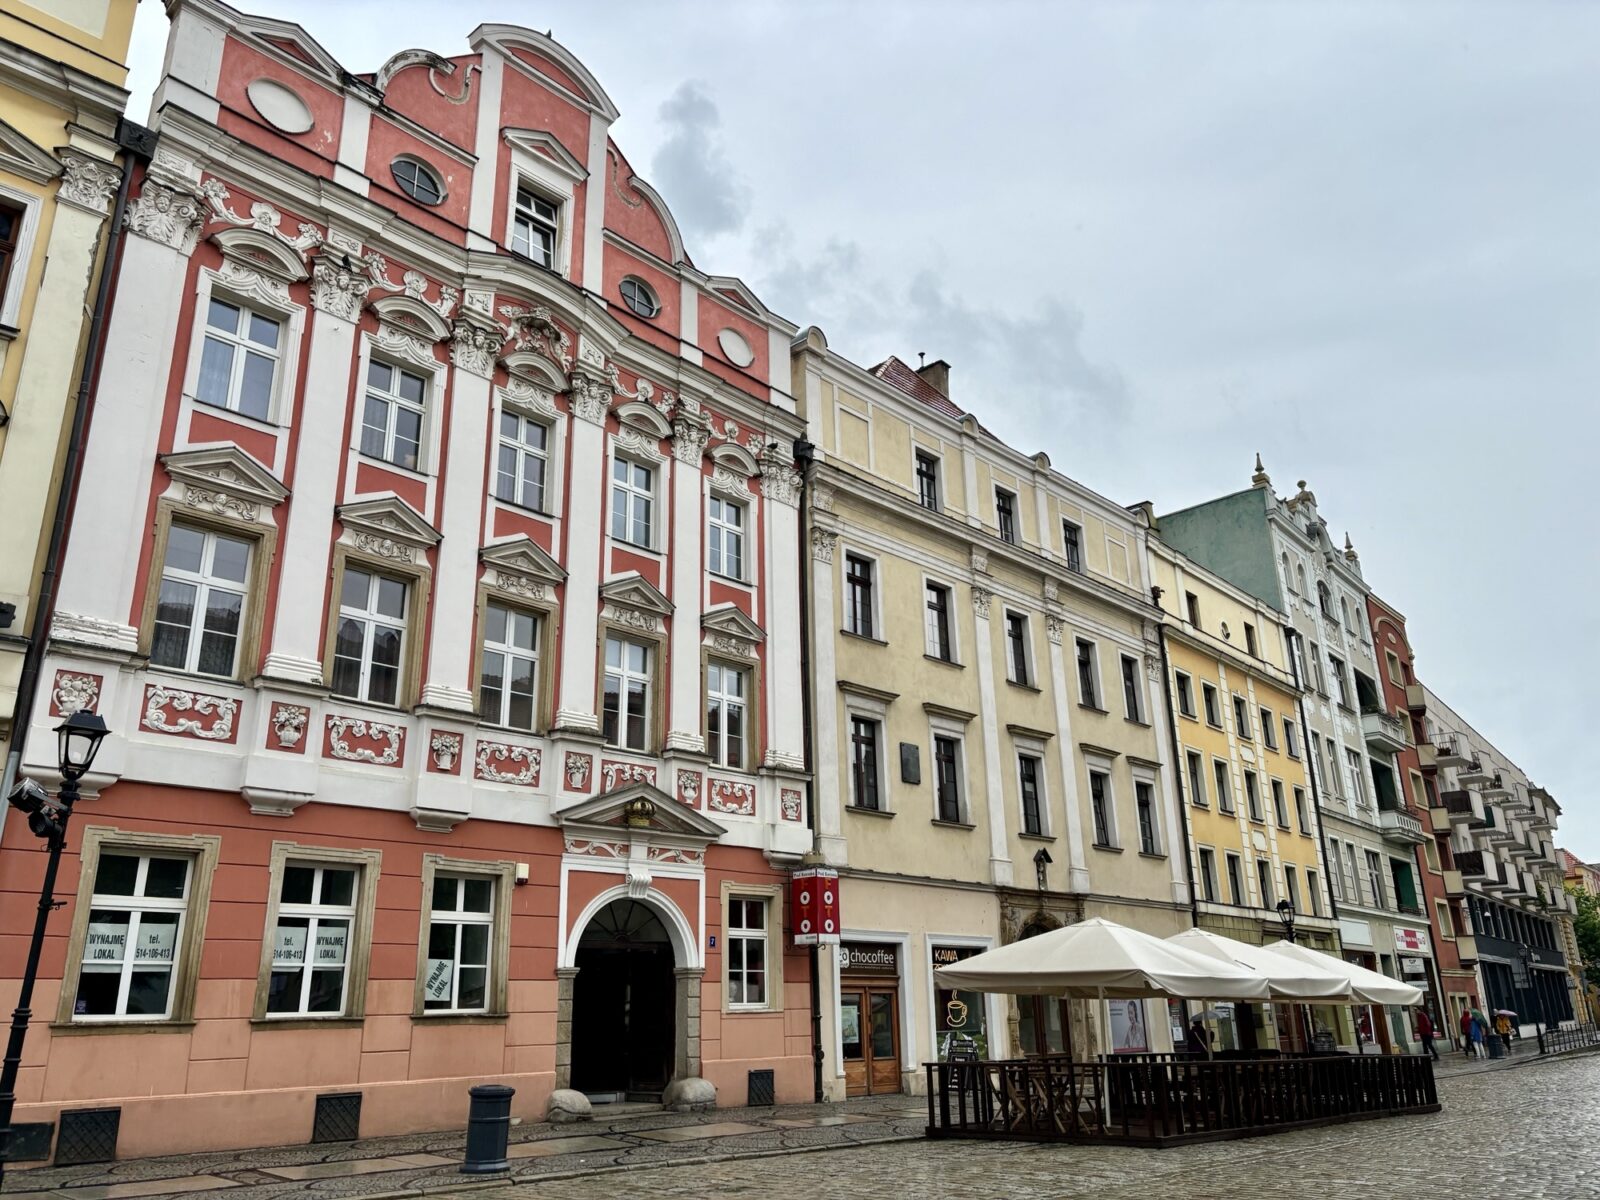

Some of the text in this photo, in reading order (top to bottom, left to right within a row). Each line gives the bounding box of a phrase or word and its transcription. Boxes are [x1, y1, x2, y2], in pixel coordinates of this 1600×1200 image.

[824, 877, 834, 933] FOTO
[89, 934, 124, 947] WYNAJMĘ
[149, 934, 160, 944] tel.
[283, 937, 293, 946] tel.
[316, 936, 344, 948] WYNAJMĘ
[93, 949, 115, 960] LOKAL
[320, 949, 336, 959] LOKAL
[850, 948, 894, 964] chocoffee
[934, 949, 958, 962] KAWA
[426, 961, 448, 990] WYNAJMĘ
[432, 979, 448, 998] LOKAL
